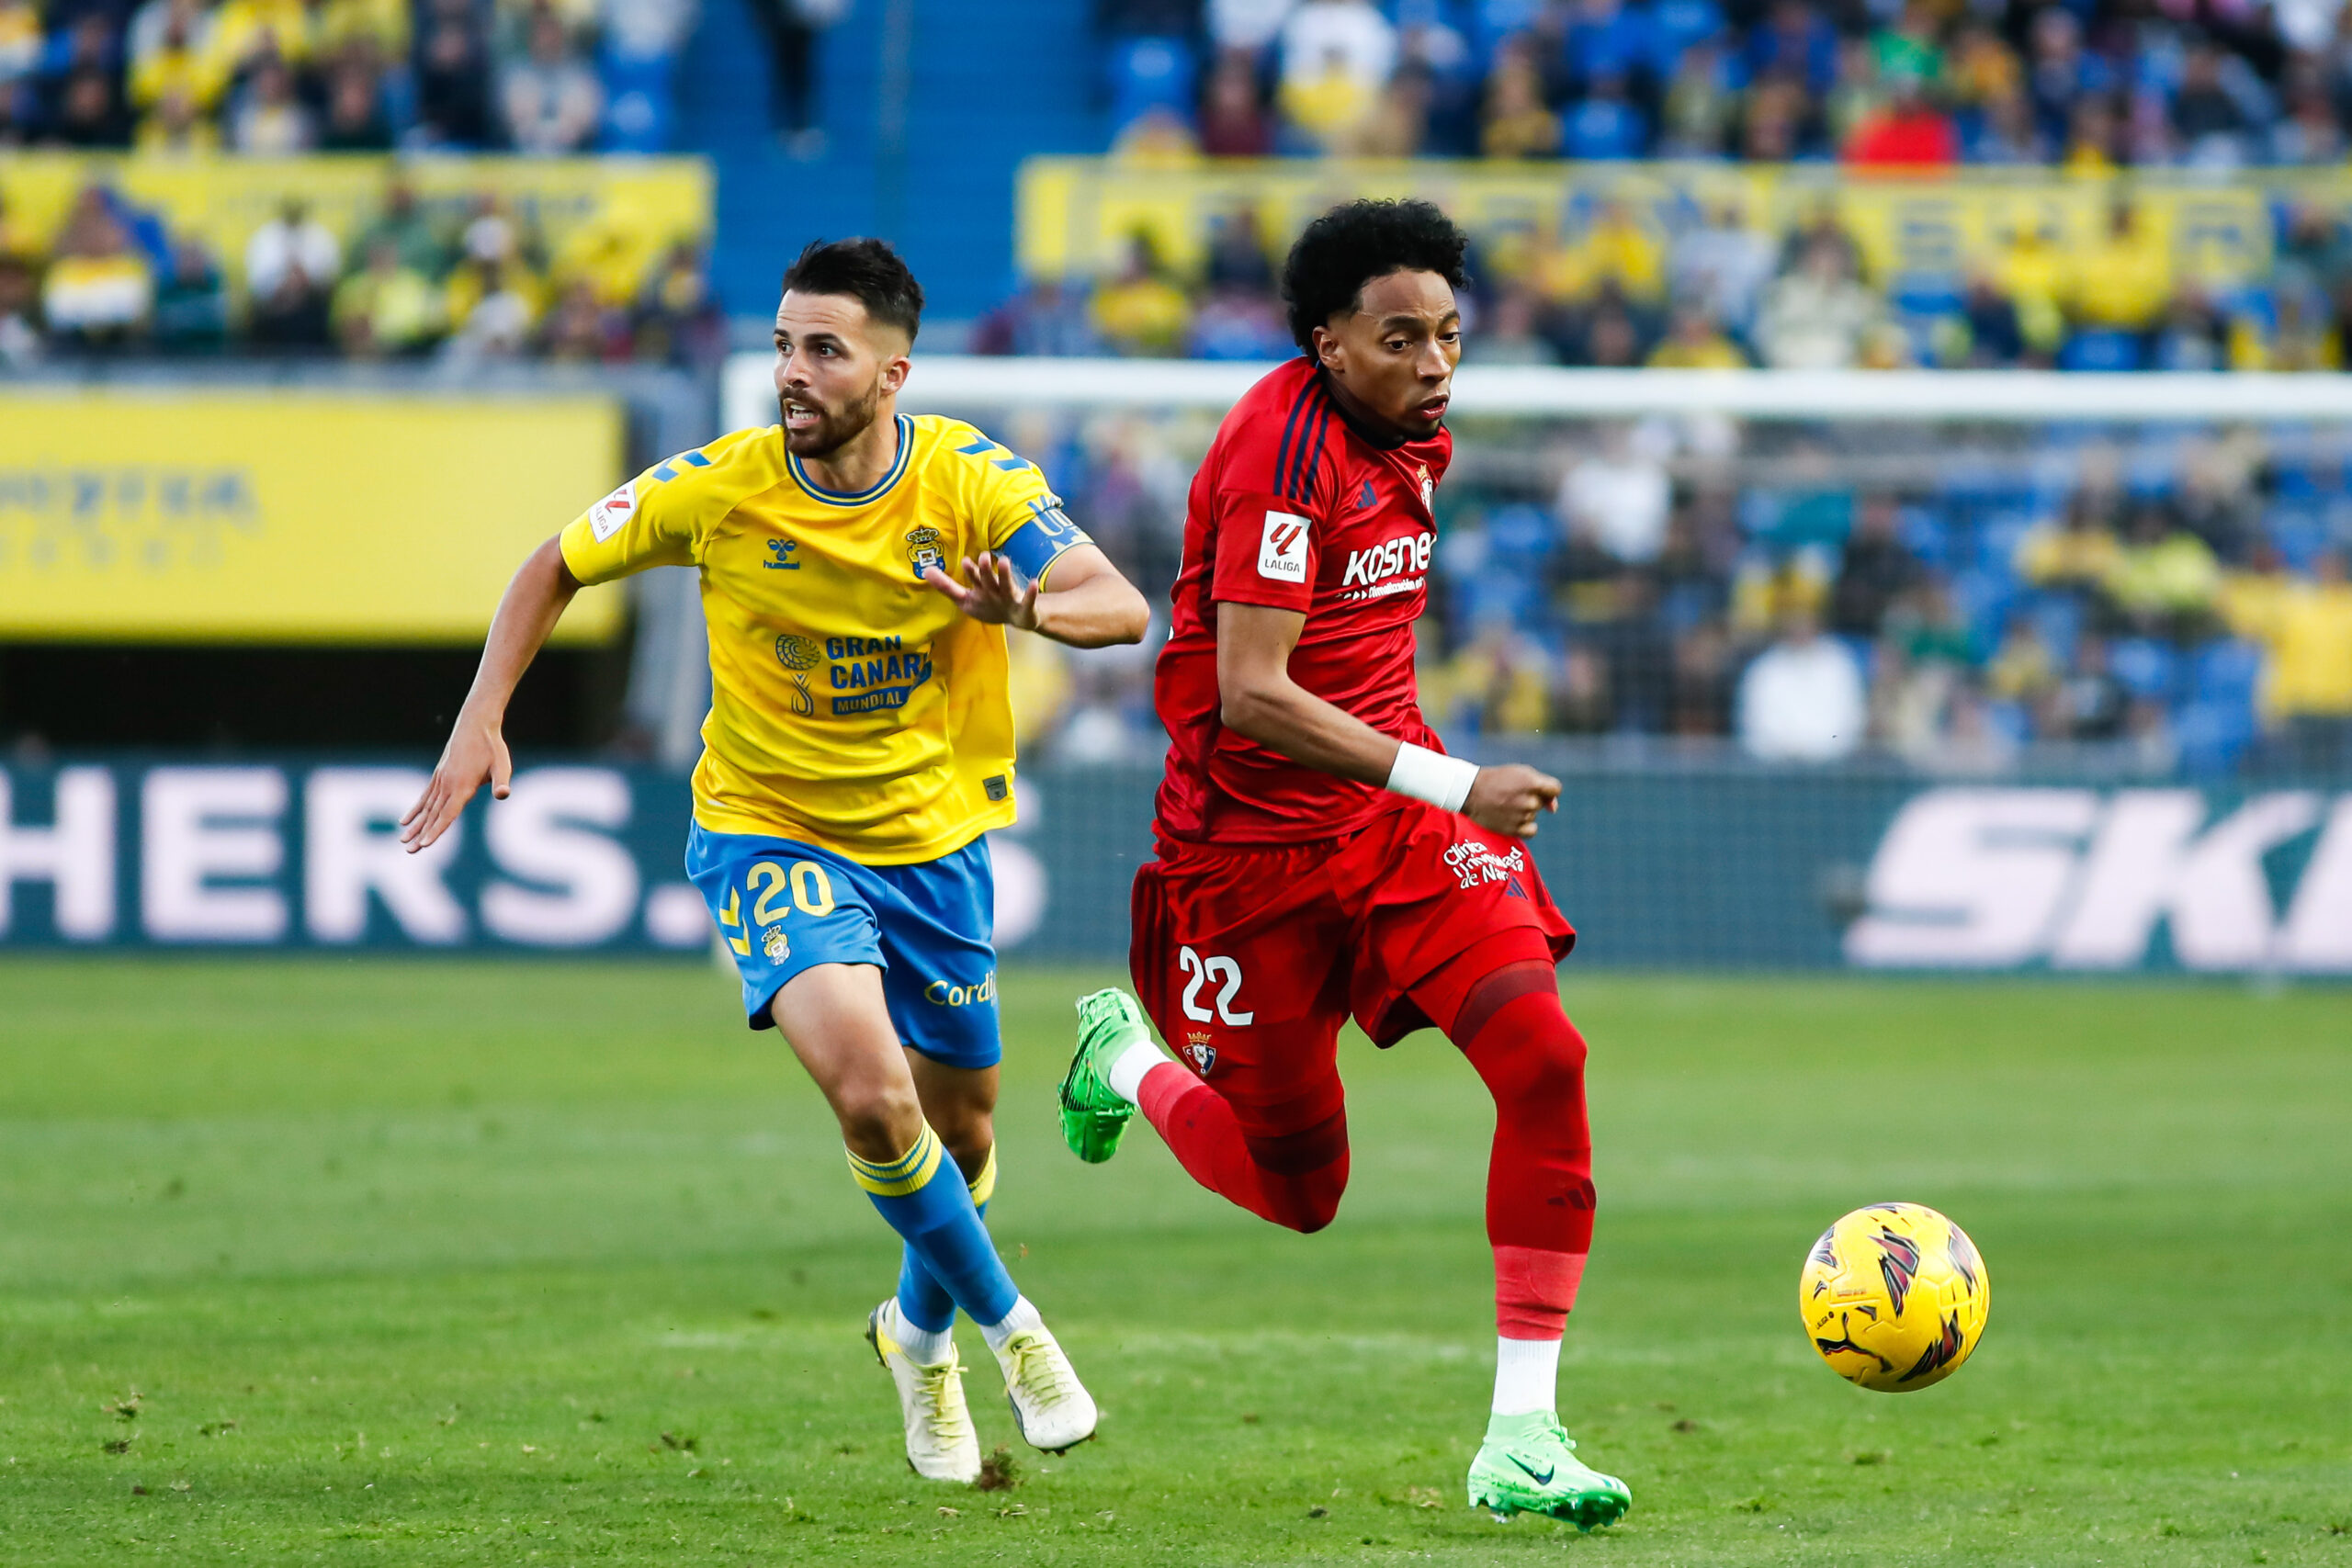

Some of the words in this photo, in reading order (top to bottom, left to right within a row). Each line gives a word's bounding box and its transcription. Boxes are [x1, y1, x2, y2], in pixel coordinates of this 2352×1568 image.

[1264, 558, 1301, 573] LALIGA
[826, 635, 901, 660] GRAN
[831, 653, 928, 689] CANAR
[837, 691, 903, 712] MUNDIAL
[1460, 874, 1479, 889] de
[746, 861, 835, 928] 20
[1180, 945, 1253, 1026] 22
